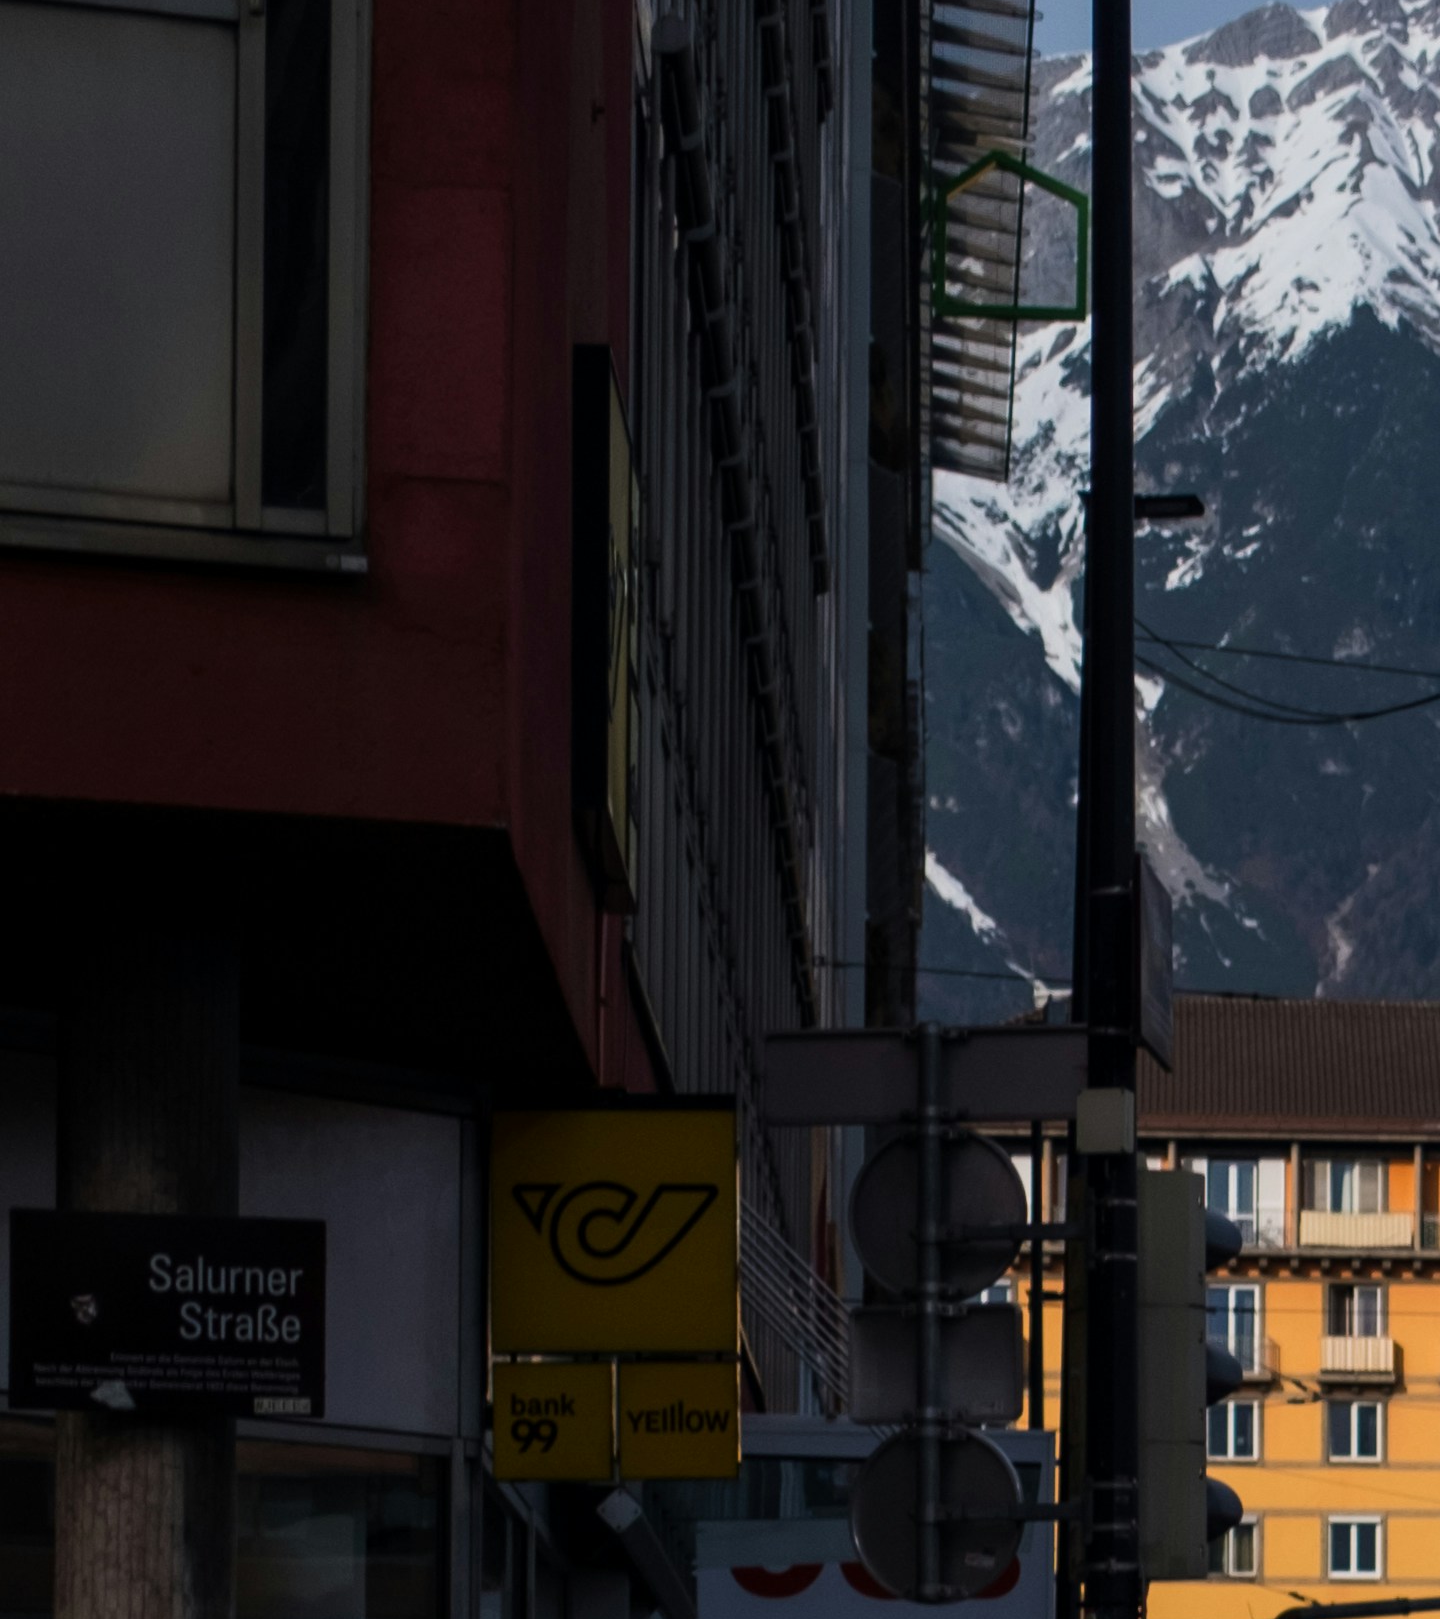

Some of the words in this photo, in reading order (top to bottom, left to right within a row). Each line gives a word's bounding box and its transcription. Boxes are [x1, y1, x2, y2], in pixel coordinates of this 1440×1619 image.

[149, 1252, 303, 1296] Salurner
[178, 1301, 301, 1343] Straße
[511, 1393, 575, 1416] bank
[511, 1419, 557, 1453] 99
